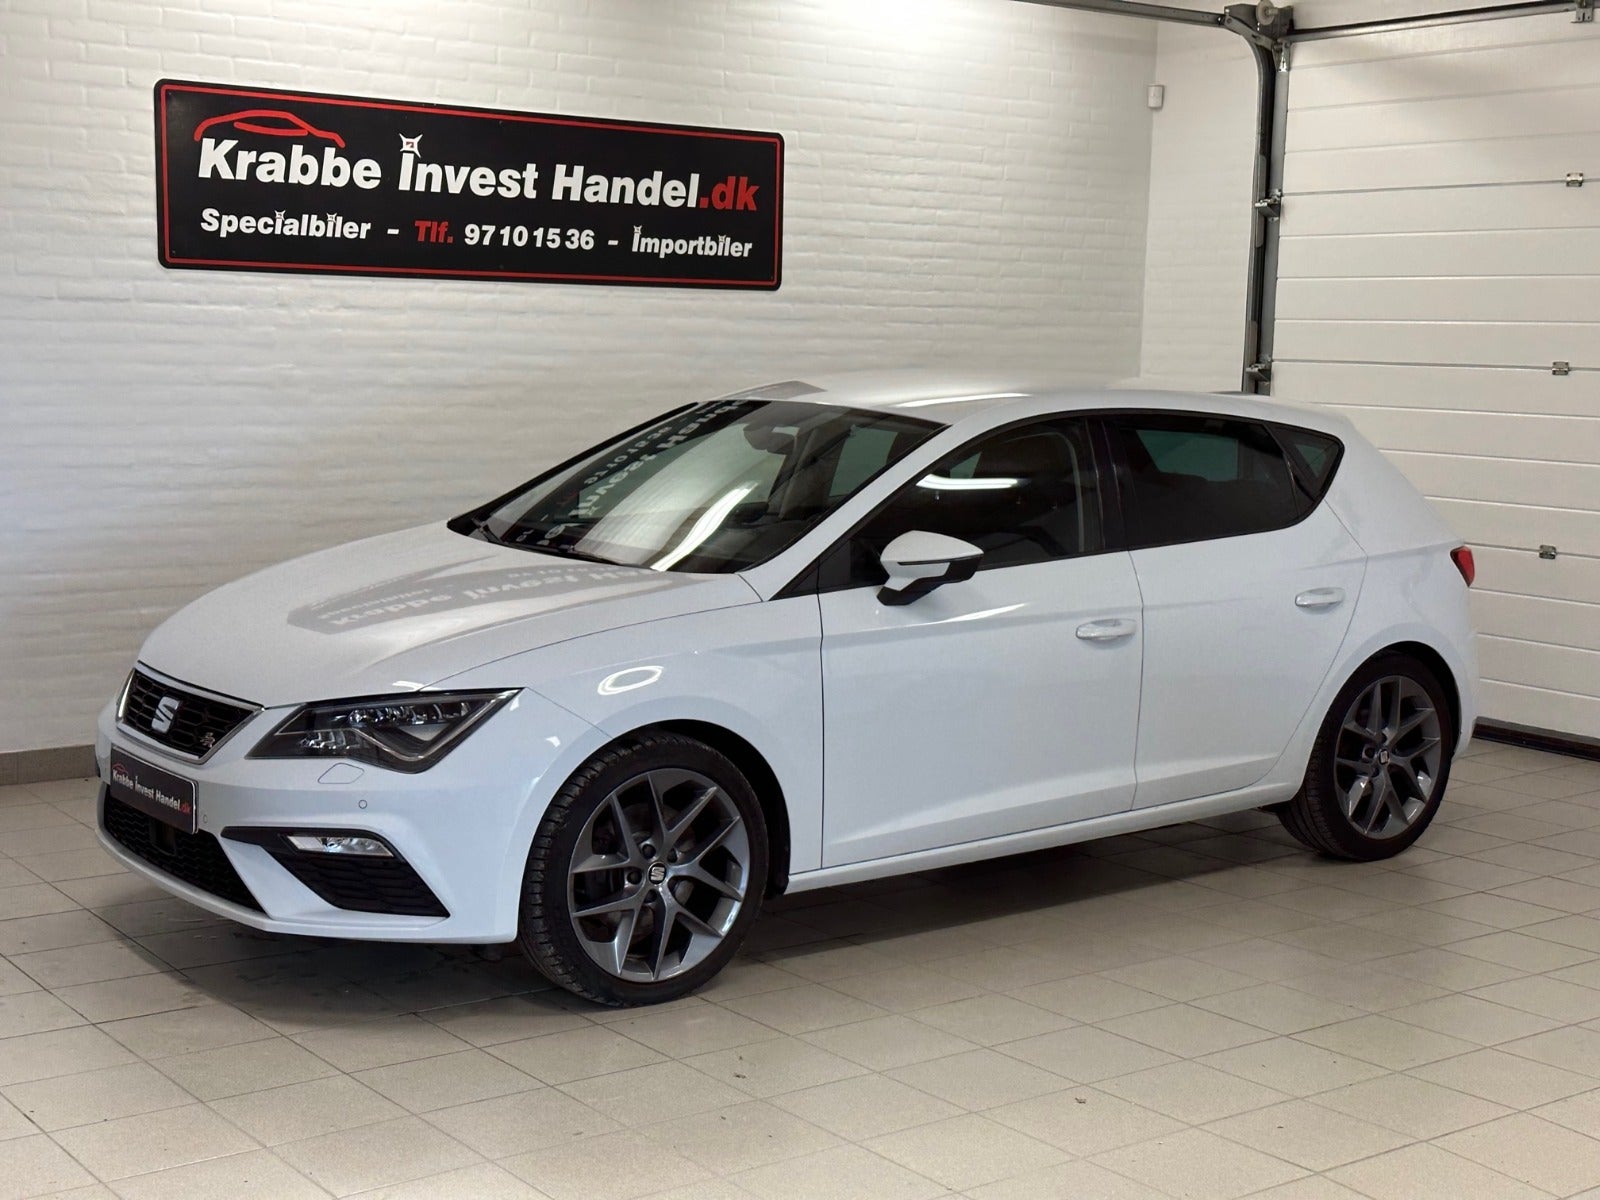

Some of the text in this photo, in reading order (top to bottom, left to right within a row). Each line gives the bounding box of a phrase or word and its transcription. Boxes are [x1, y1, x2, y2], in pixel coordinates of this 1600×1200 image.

[198, 133, 760, 212] Krabbe Invest Handel.dk
[200, 207, 371, 238] Specialbiler
[414, 220, 453, 243] Tlf.
[631, 225, 752, 258] Importbiler
